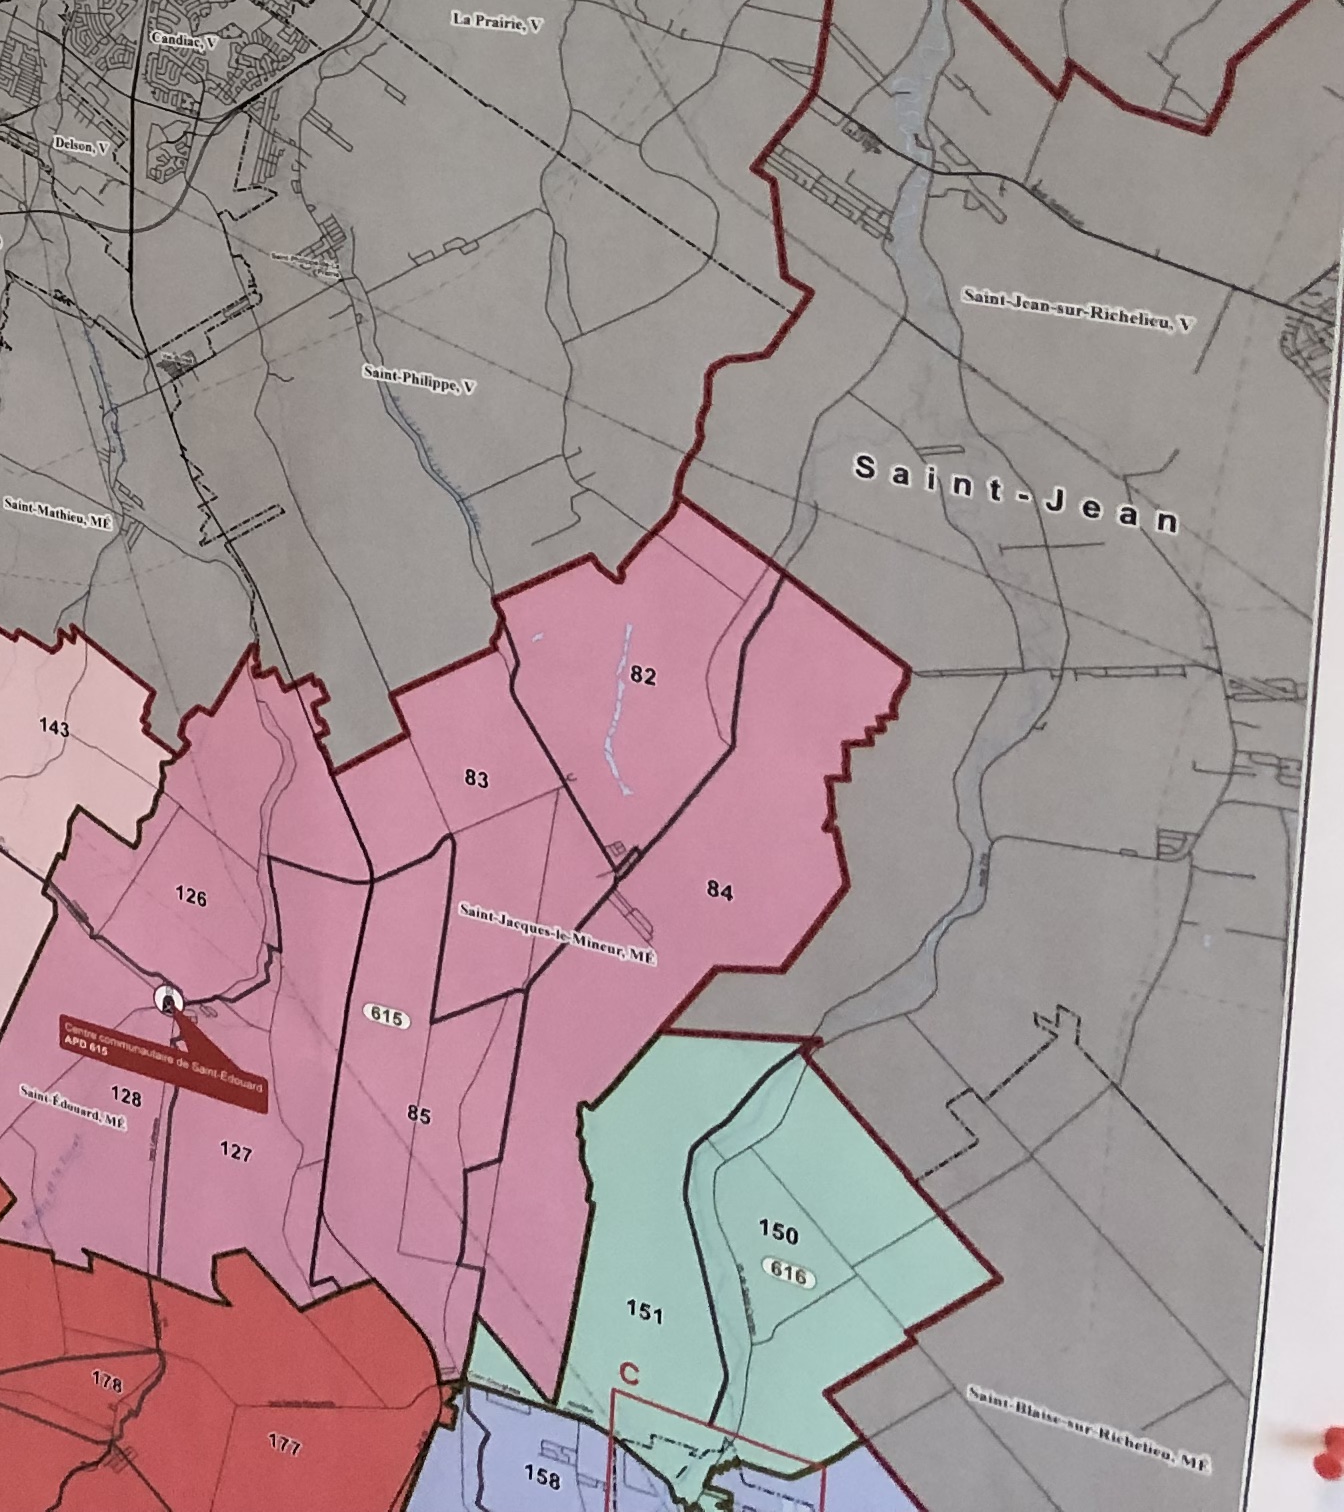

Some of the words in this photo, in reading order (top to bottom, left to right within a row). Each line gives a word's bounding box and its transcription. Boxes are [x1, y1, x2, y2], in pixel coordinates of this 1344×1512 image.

[454, 12, 471, 26] La
[56, 136, 96, 154] Delson,
[364, 366, 461, 394] Saint-Philippe,
[4, 497, 87, 526] Saint-Mathieu,
[629, 664, 657, 687] 82
[38, 716, 71, 738] 143
[463, 768, 490, 789] 83
[174, 884, 208, 908] 126
[706, 879, 734, 901] 84
[369, 1005, 404, 1027] 615
[65, 1034, 88, 1049] APD
[89, 1042, 109, 1057] 615
[110, 1085, 143, 1108] 128
[406, 1104, 432, 1125] 85
[219, 1140, 253, 1164] 127
[758, 1218, 800, 1245] 150
[770, 1260, 808, 1286] 616
[625, 1298, 665, 1326] 151
[91, 1370, 124, 1393] 178
[619, 1361, 640, 1386] C
[267, 1432, 302, 1457] 177
[522, 1463, 562, 1492] 158
